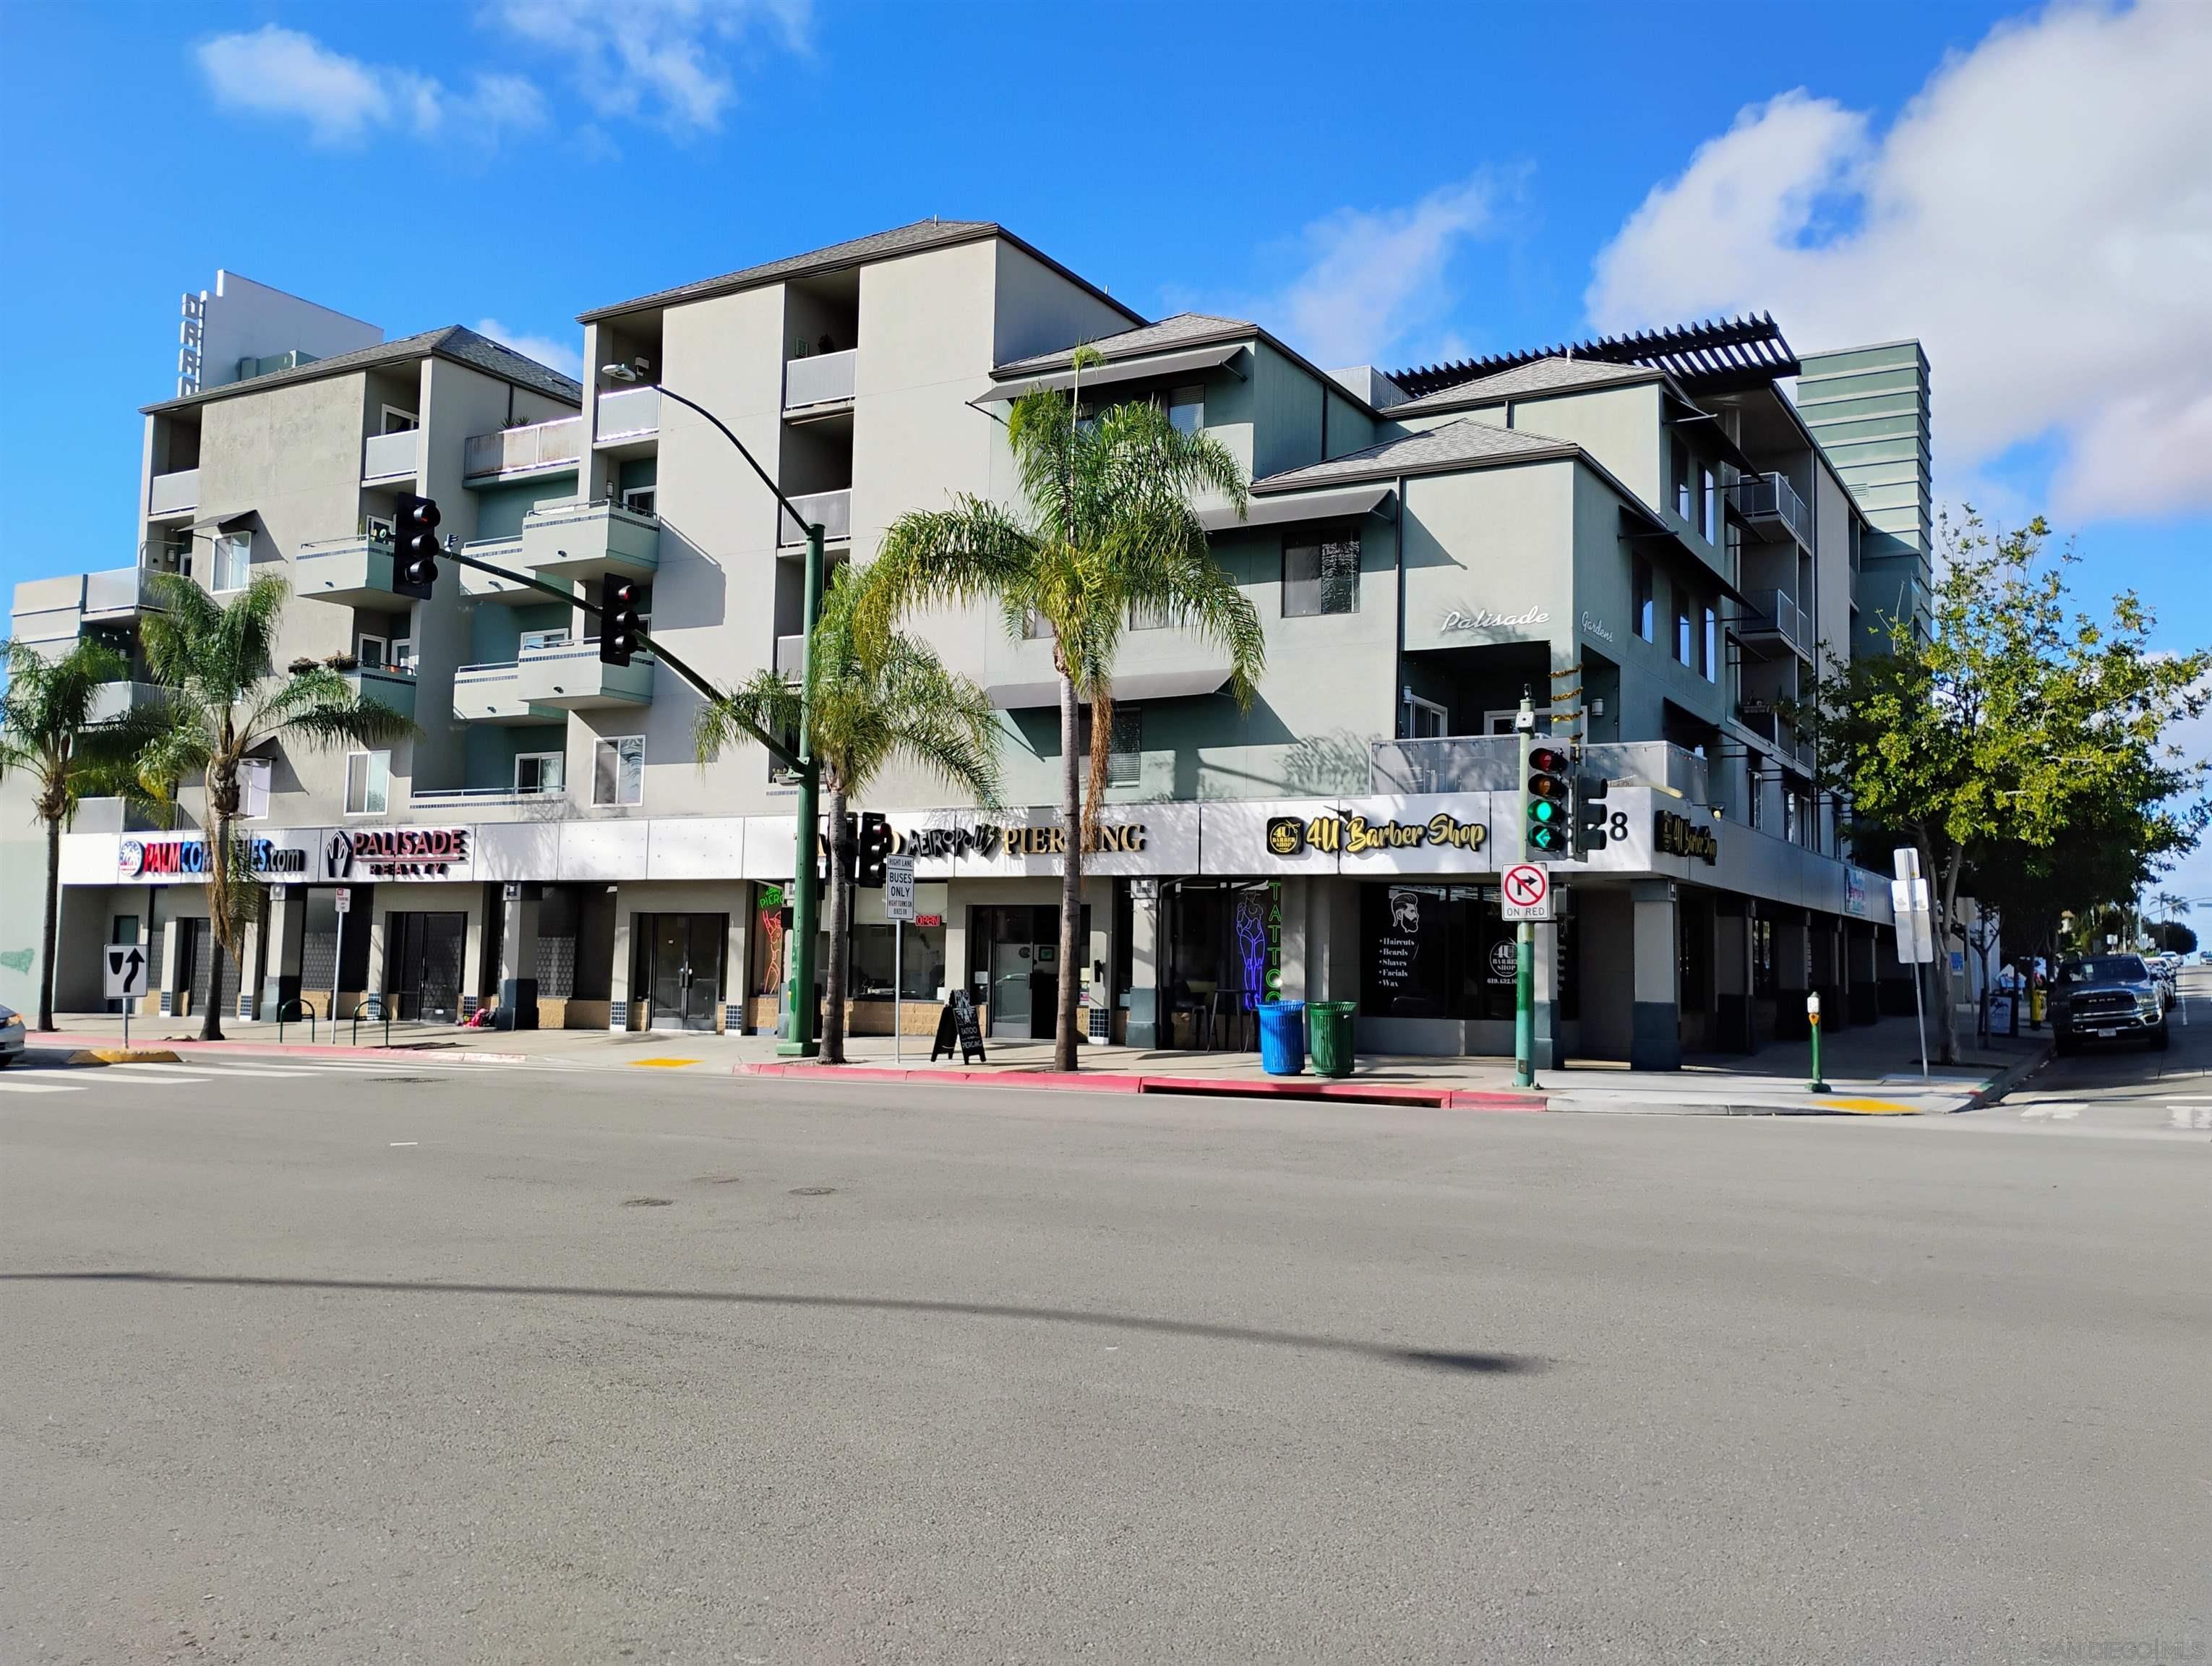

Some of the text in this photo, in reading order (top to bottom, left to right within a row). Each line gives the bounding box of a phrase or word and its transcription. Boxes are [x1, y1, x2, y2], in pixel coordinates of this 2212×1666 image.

[1440, 605, 1551, 631] Palisade
[1581, 611, 1613, 642] Gardens
[1273, 826, 1290, 837] 4U
[1306, 813, 1486, 853] 4U Barber Shop
[353, 829, 462, 856] PALISADE
[369, 863, 441, 875] REALTY
[890, 872, 912, 884] BUSES
[891, 886, 910, 897] ONLY
[1507, 907, 1545, 916] ON RED
[917, 915, 938, 926] OPEN
[1493, 945, 1515, 958] 4U
